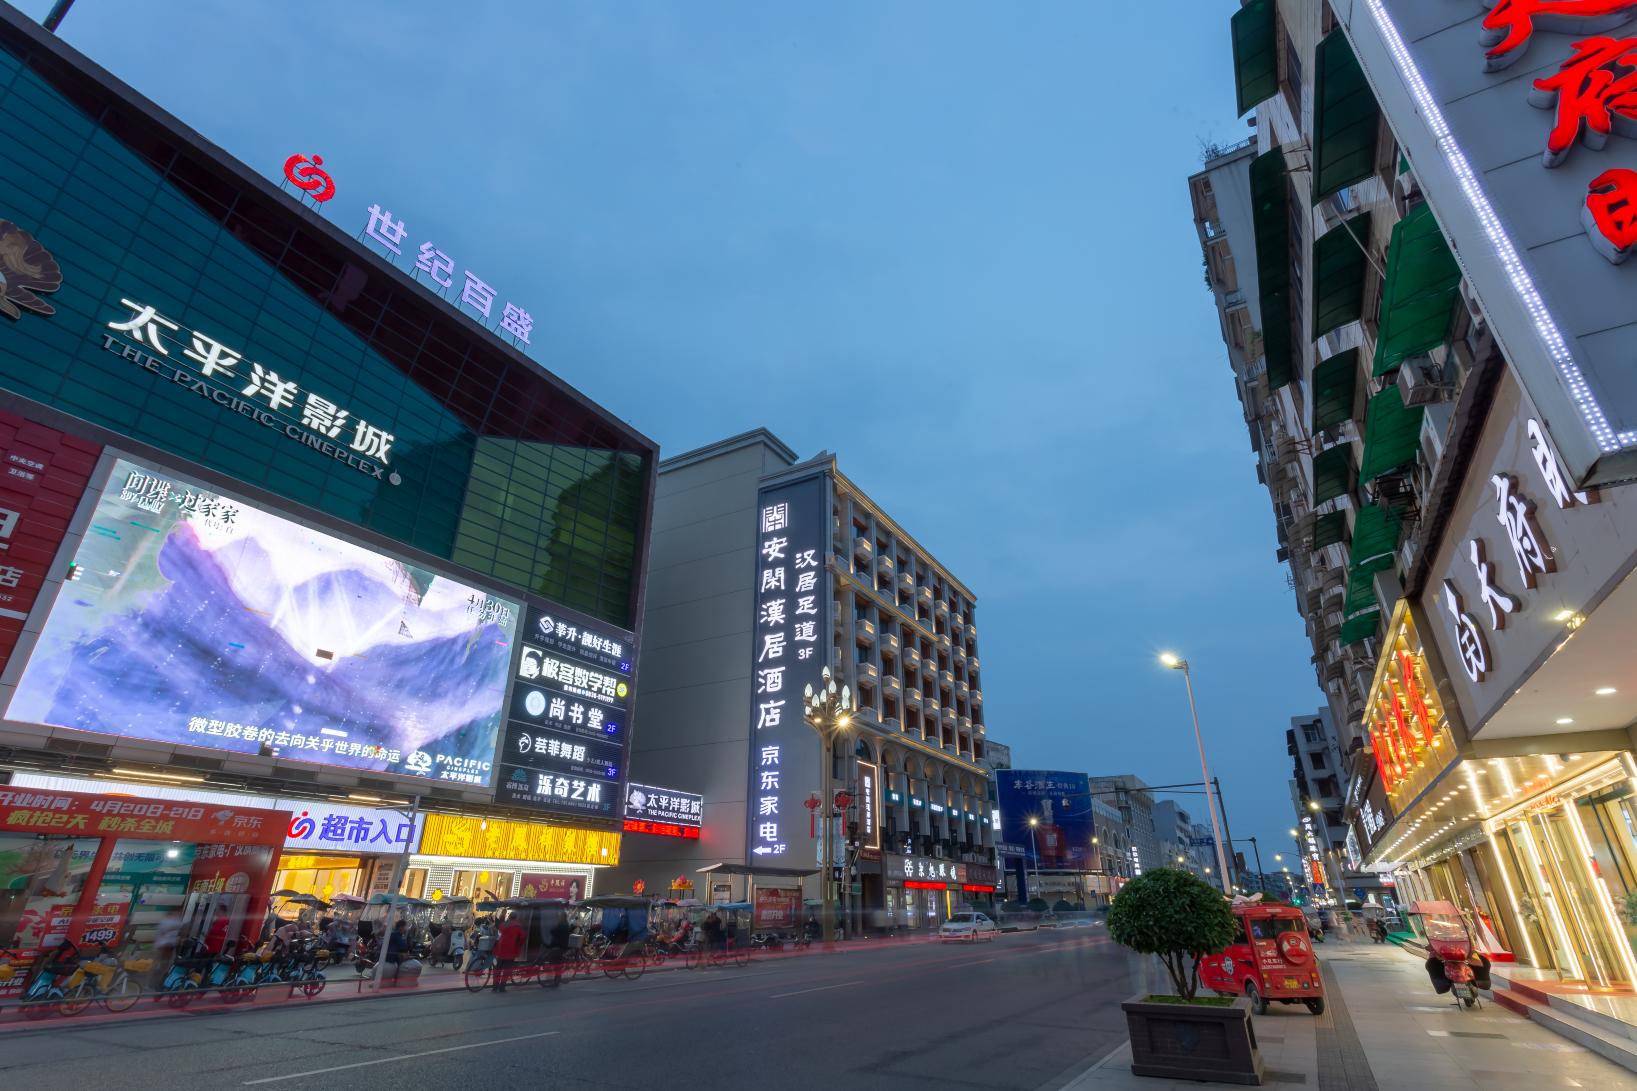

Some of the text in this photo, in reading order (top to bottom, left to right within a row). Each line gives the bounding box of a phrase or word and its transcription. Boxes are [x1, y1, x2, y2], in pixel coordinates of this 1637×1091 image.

[365, 203, 535, 345] 世纪百盛
[108, 297, 396, 465] 太平洋影城
[101, 333, 385, 481] THE PACIFIC CINEPLEX
[10, 454, 44, 470] 中央空调
[795, 549, 818, 642] 汉居足道
[467, 594, 510, 618] 4月30日
[798, 648, 813, 659] 3F
[620, 662, 630, 671] 2F
[541, 657, 617, 697] 极客数学帮
[549, 697, 603, 730] 尚书堂
[607, 724, 616, 732] 2F
[188, 716, 401, 763] 微型胶卷的去向关乎世界的命运
[534, 737, 586, 762] 芸菲舞蹈
[435, 754, 491, 771] PACIFIC
[607, 767, 617, 777] 3F
[440, 770, 482, 784] 太平洋影城
[759, 745, 780, 841] 京东家电
[90, 800, 205, 820] 4月20日-21日
[602, 803, 611, 811] 3F
[647, 793, 700, 814] 太平洋影城
[6, 810, 176, 835] 疯抢2天 秒杀全城
[232, 815, 263, 829] 京东
[648, 808, 701, 821] THE PACIFIC CINEPLEX
[318, 814, 416, 844] 超市入口
[773, 844, 786, 854] 2F
[84, 929, 113, 942] 1499
